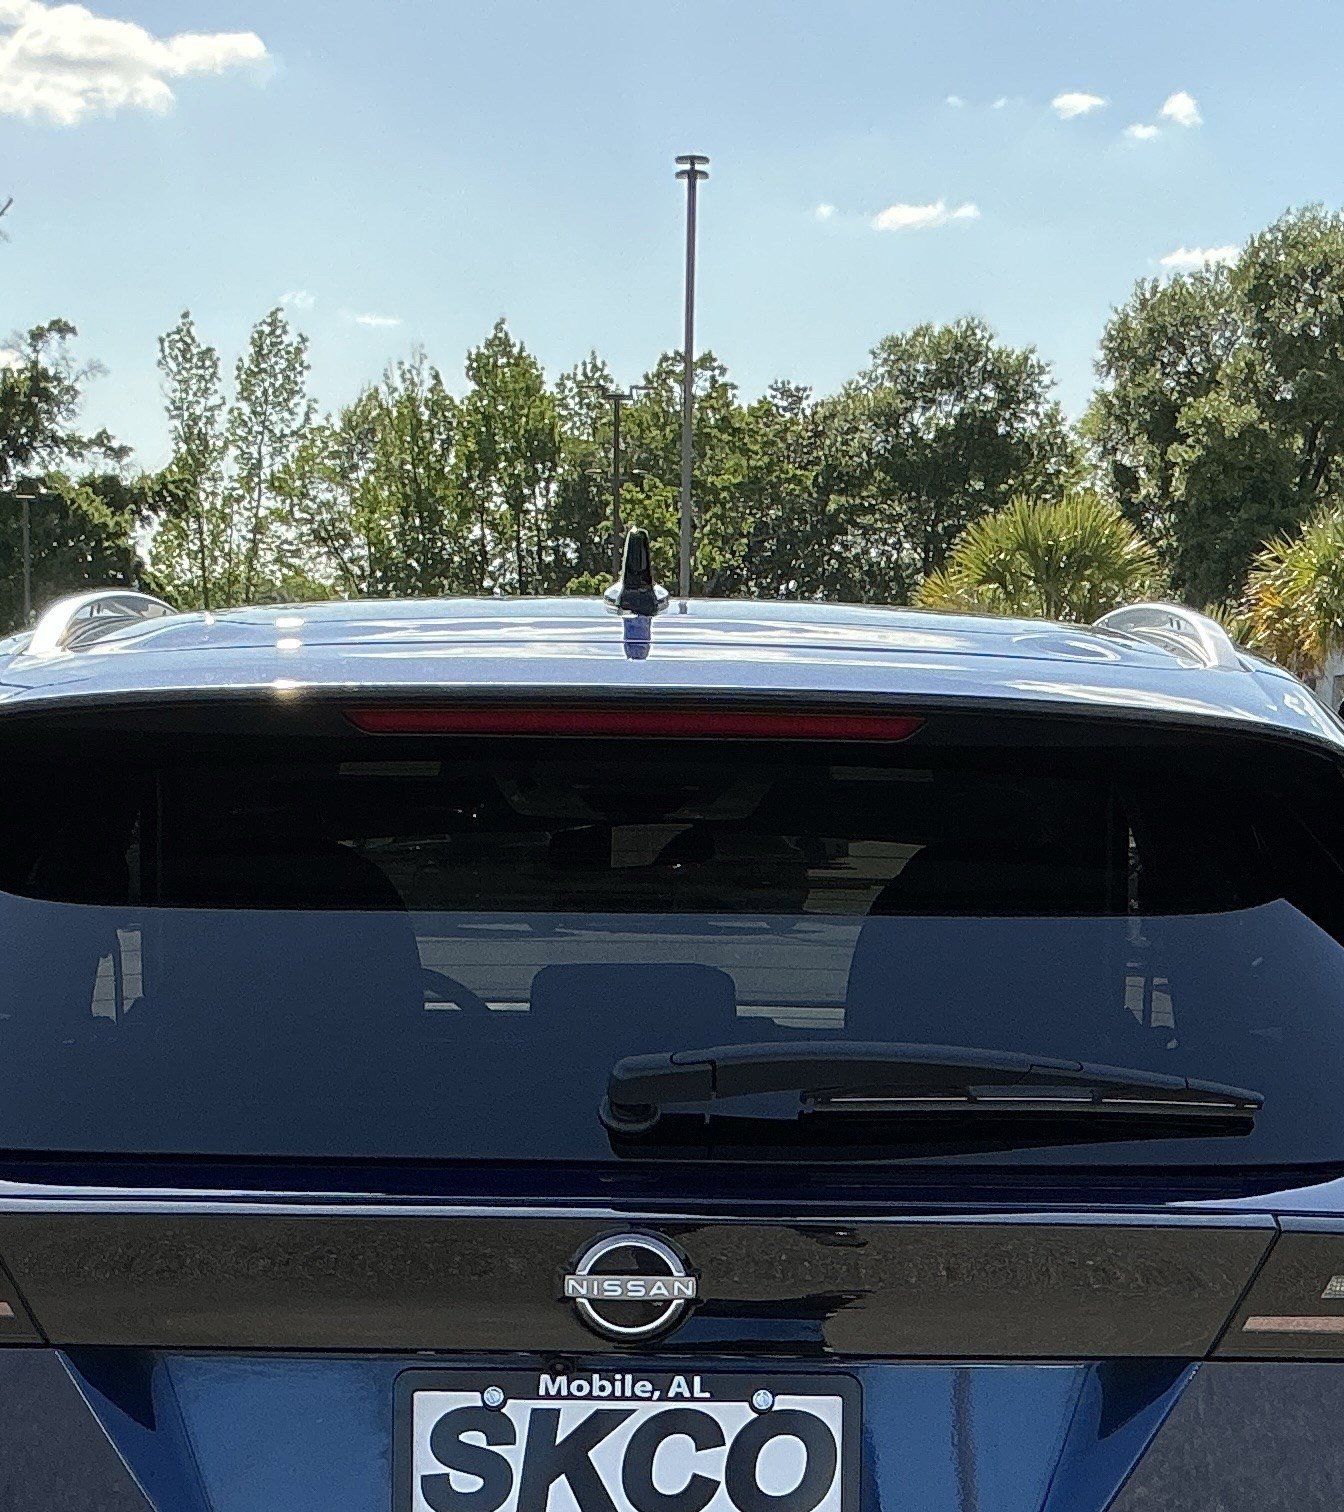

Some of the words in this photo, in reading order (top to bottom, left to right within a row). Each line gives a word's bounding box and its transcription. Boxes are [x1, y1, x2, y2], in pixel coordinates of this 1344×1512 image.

[567, 1279, 694, 1297] NISSAN
[538, 1374, 661, 1401] Mobile,
[669, 1376, 711, 1398] AL
